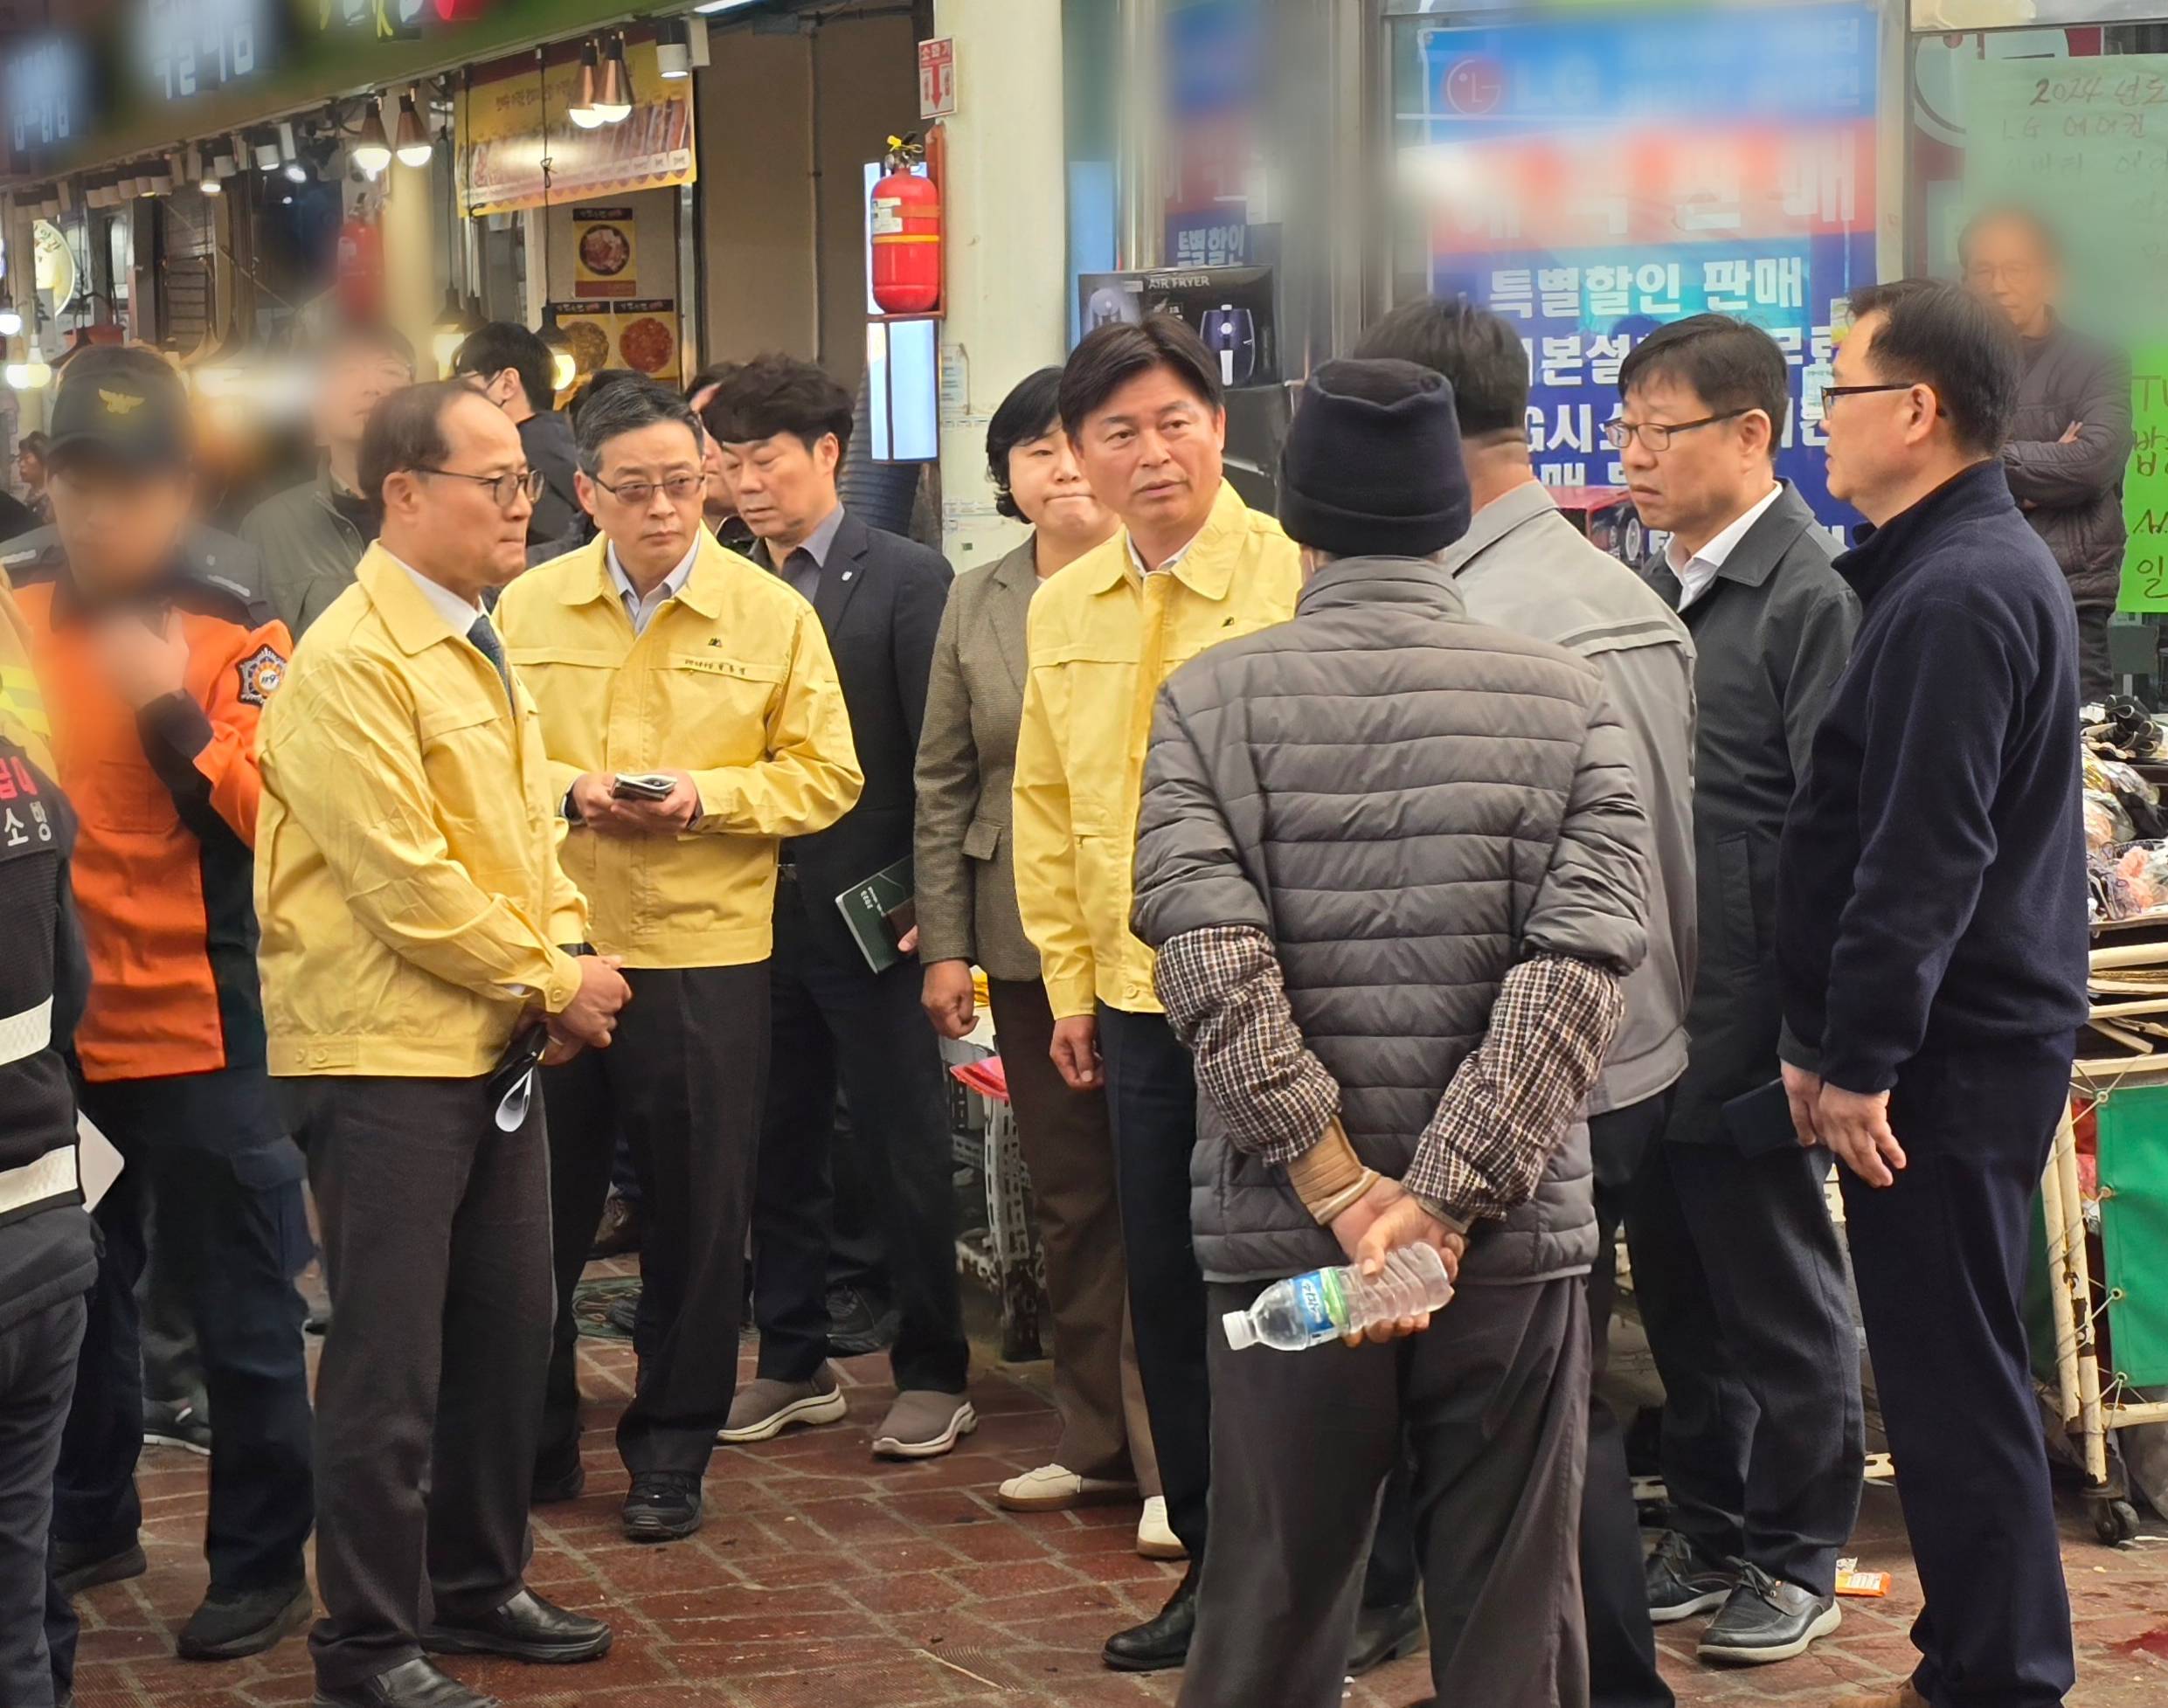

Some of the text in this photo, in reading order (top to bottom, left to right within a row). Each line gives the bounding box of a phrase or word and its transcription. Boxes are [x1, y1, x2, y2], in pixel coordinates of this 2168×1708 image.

[2029, 75, 2104, 107] 2024
[1148, 275, 1210, 289] AIR FRYER
[1490, 257, 1803, 318] 특별할인 판매
